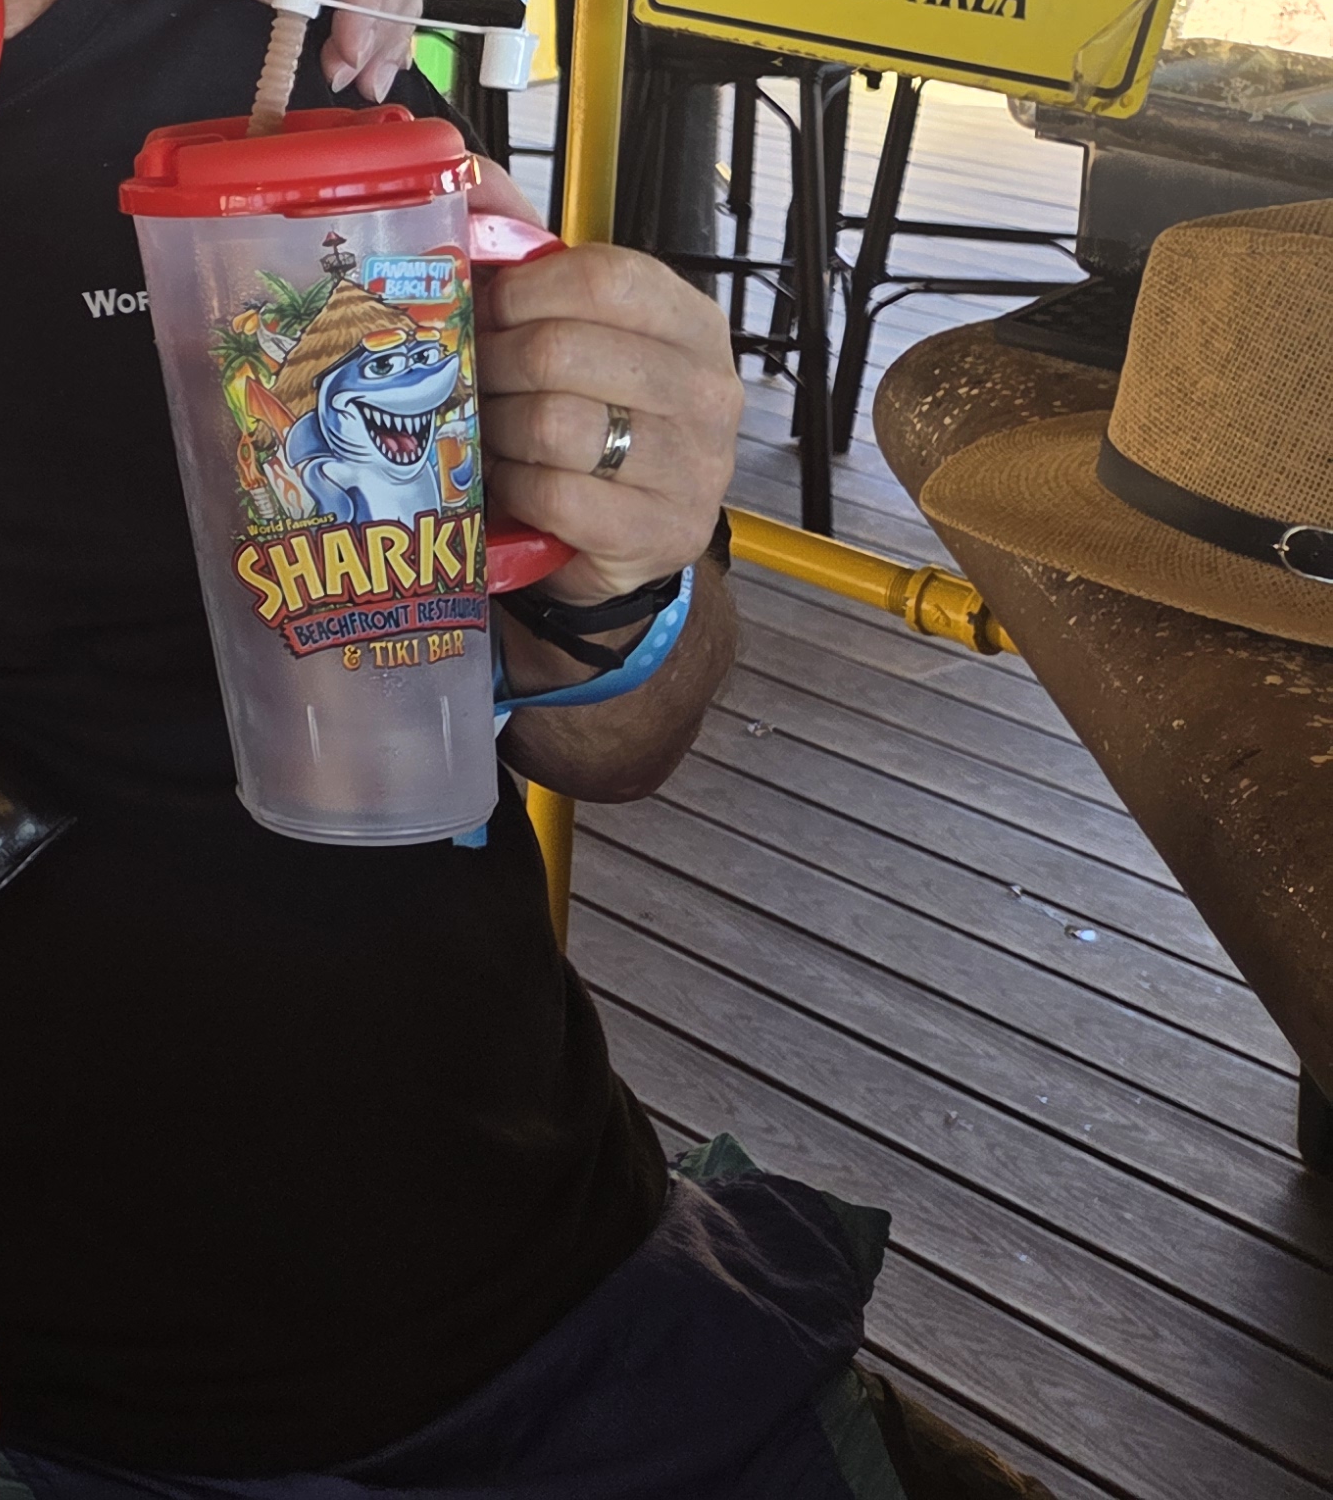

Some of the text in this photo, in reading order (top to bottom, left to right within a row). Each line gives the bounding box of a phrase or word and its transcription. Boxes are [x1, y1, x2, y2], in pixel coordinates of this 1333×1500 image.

[374, 261, 452, 280] PANAMA CITY
[431, 280, 441, 297] FL
[247, 513, 334, 536] World Famous
[294, 604, 410, 647] BEACHFRONT
[343, 629, 464, 670] & TIKI BAR
